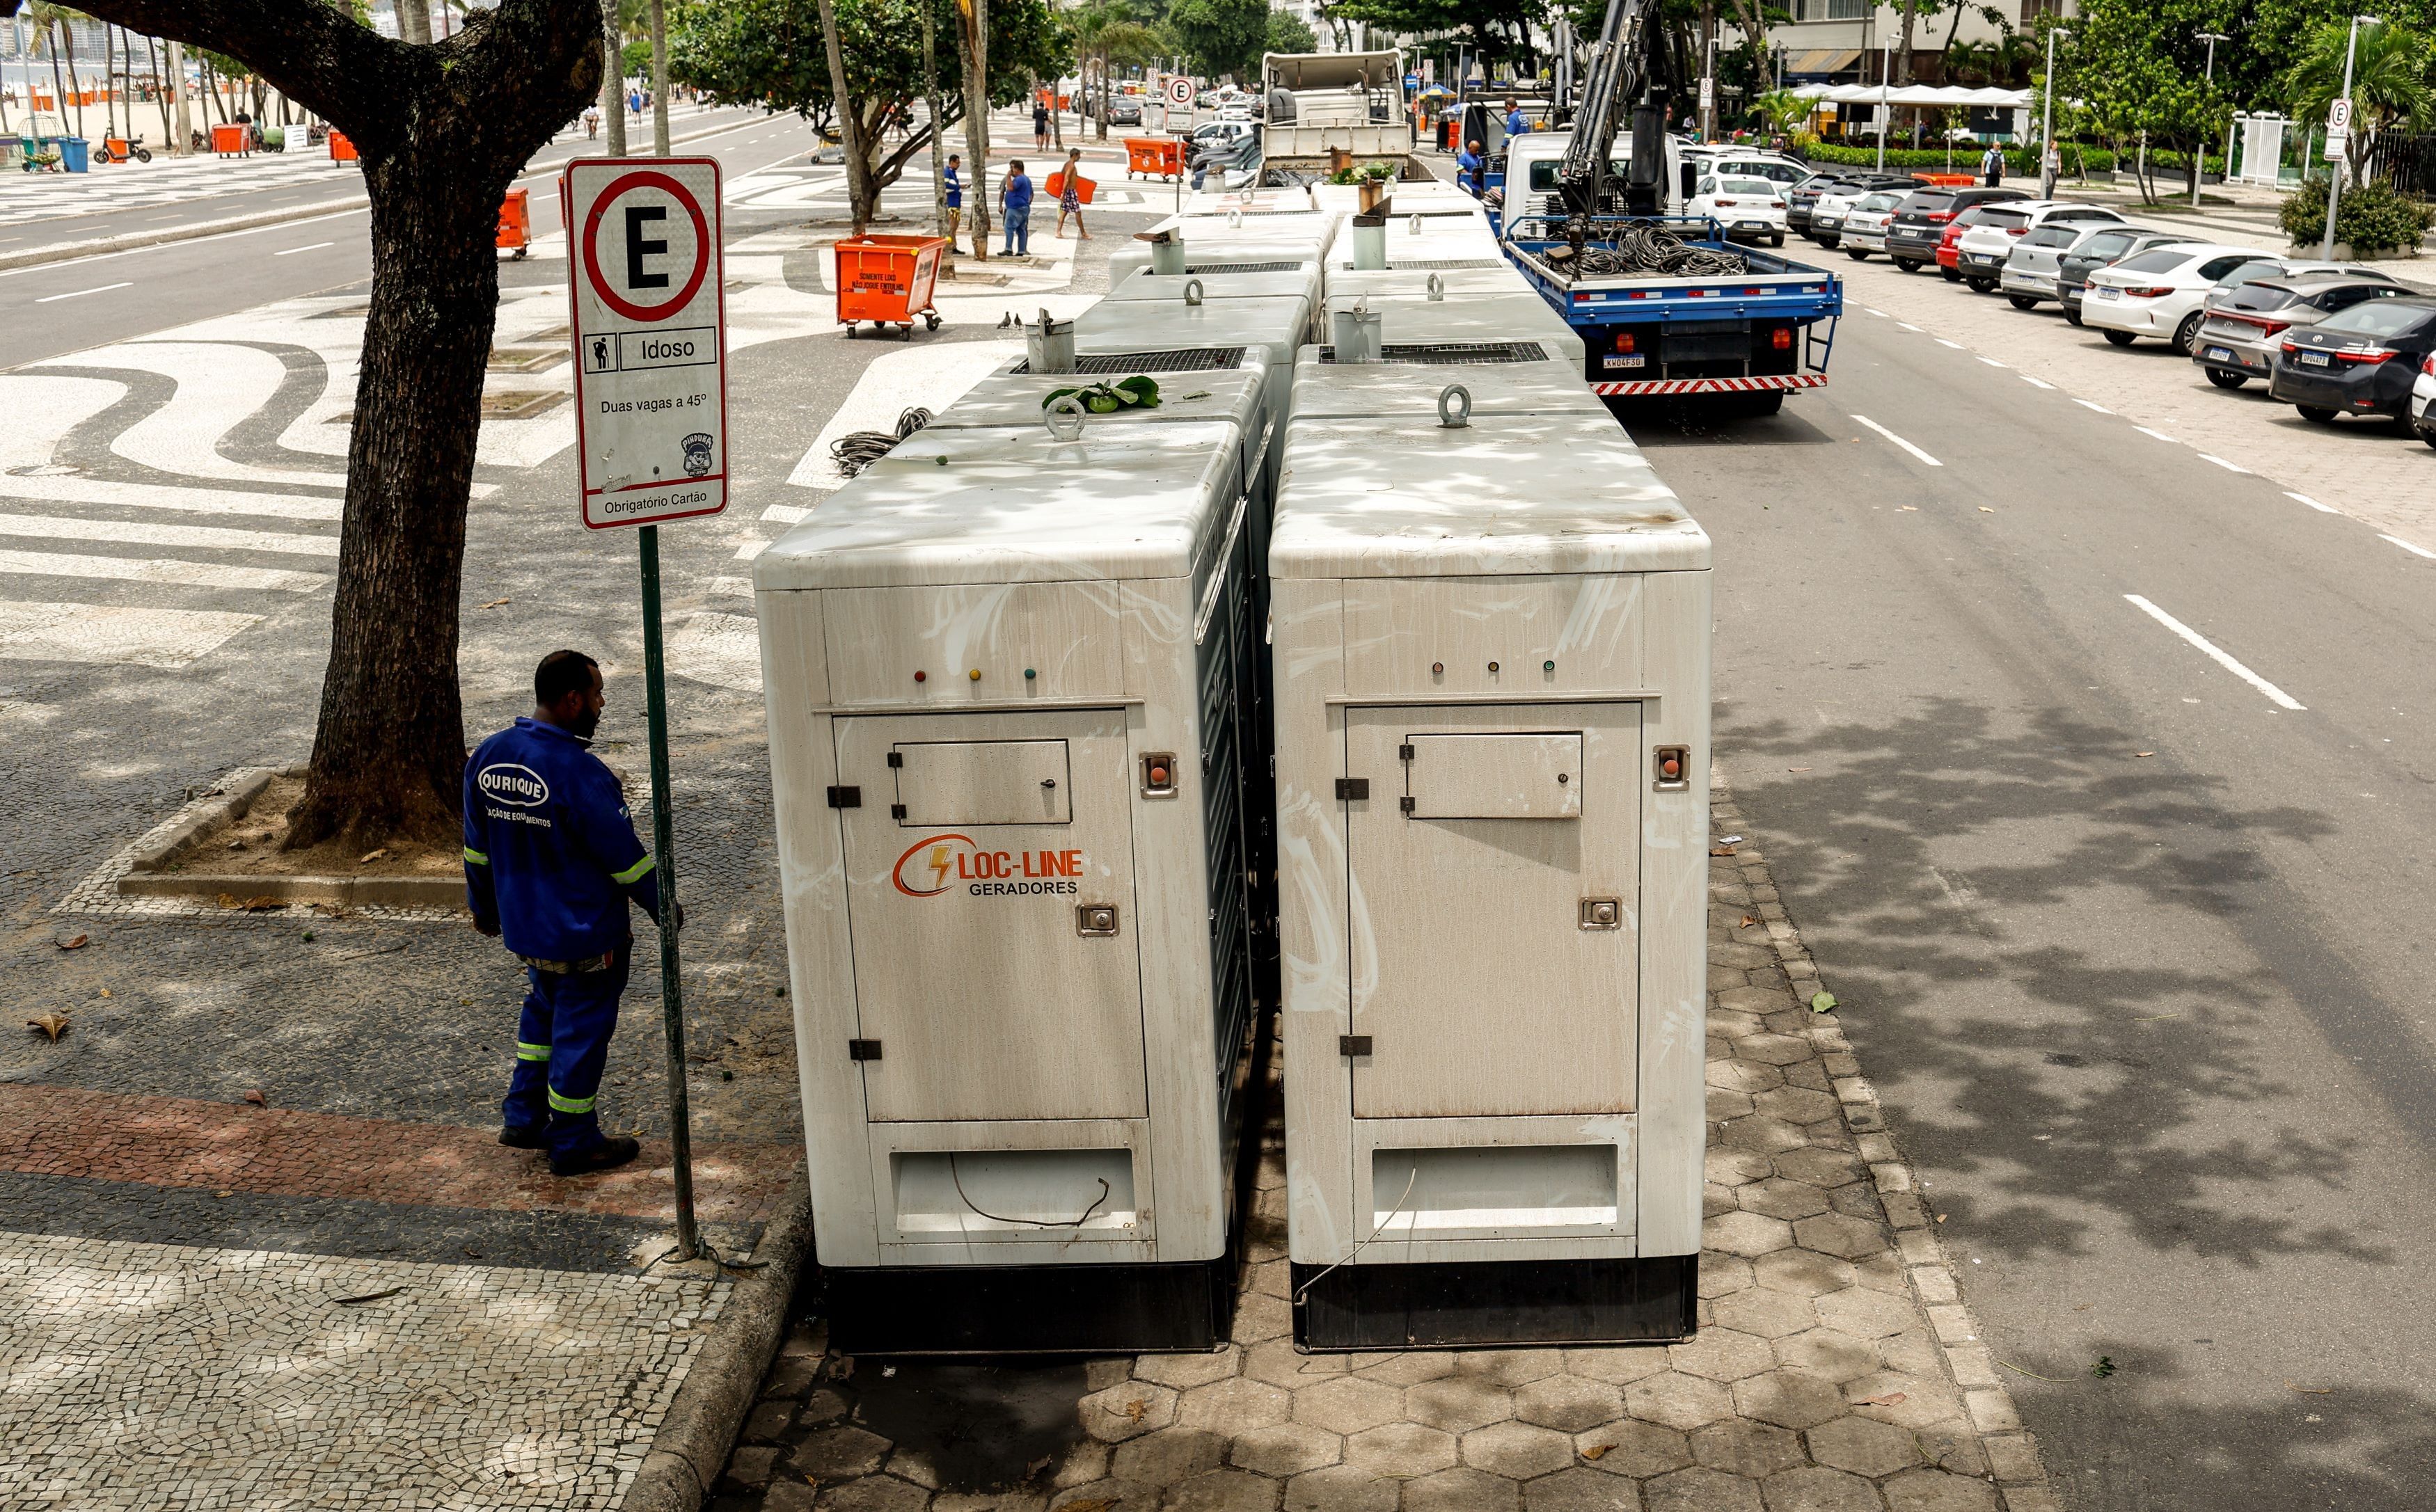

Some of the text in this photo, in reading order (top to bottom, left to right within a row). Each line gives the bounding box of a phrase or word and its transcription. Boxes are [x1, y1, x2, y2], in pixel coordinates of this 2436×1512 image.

[1177, 85, 1185, 97] E
[2336, 108, 2343, 121] E
[625, 206, 670, 289] E
[851, 280, 863, 289] NÃO
[864, 281, 879, 289] JOGUE
[859, 272, 896, 282] SOMENTE LIXO
[642, 340, 695, 360] Idoso
[601, 401, 633, 413] Duas
[636, 399, 672, 413] vagas
[676, 397, 683, 408] a
[605, 491, 707, 514] Obrigatório Cartão
[482, 773, 541, 799] OURIQUE
[486, 806, 503, 819] AÇÃO
[503, 811, 511, 820] DE
[957, 850, 1084, 880] LOC-LINE
[968, 881, 1078, 896] GERADORES
